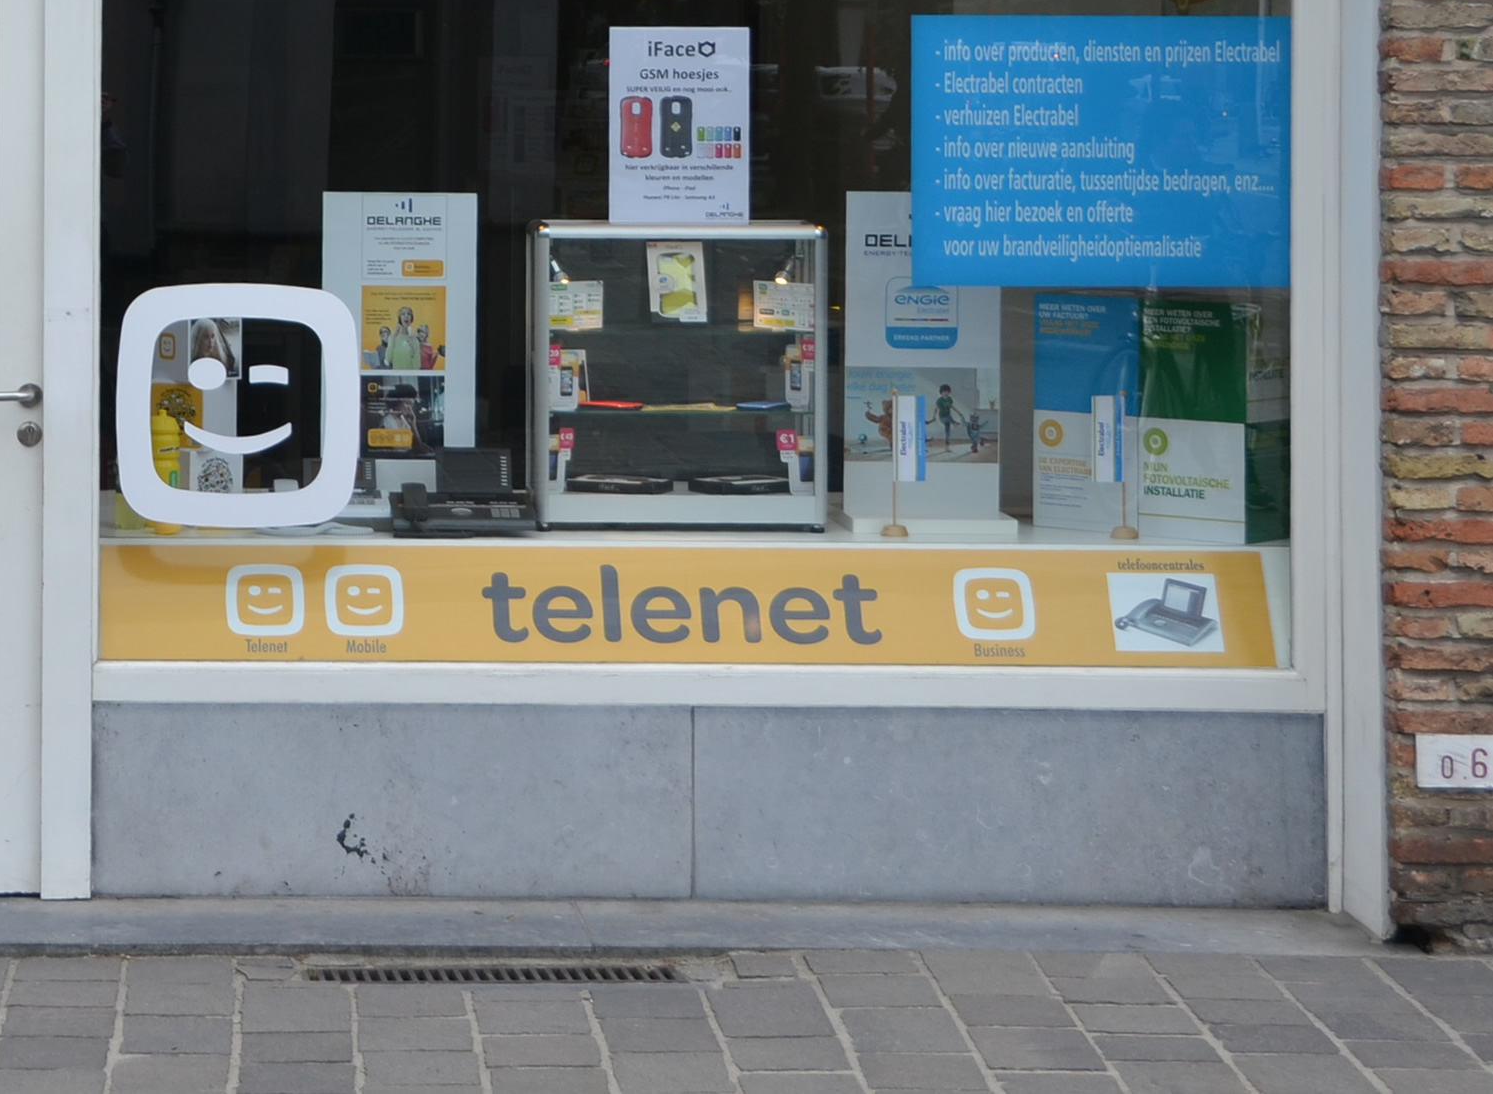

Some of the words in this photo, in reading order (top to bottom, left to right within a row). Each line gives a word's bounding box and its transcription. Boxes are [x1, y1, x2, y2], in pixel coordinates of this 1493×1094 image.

[648, 41, 696, 57] iFace
[943, 40, 970, 61] info
[975, 46, 1004, 61] over
[1008, 40, 1079, 66] producten,
[1083, 40, 1141, 62] diensten
[1144, 47, 1161, 62] en
[1165, 41, 1211, 67] prijzen
[1215, 40, 1280, 63] Electrabel
[639, 68, 669, 80] GSM
[672, 68, 719, 82] hoesjes
[944, 71, 1008, 93] Electrabel
[1012, 74, 1083, 94] contracten
[944, 104, 1009, 126] verhuizen
[1013, 104, 1078, 126] Electrabel
[943, 136, 970, 158] info
[974, 142, 1004, 158] over
[1008, 138, 1057, 158] nieuwe
[1061, 137, 1135, 163] aansluiting
[943, 168, 970, 190] info
[974, 174, 1004, 190] over
[1008, 168, 1075, 193] facturatie,
[1079, 169, 1159, 196] tussentijdse
[1163, 170, 1231, 196] bedragen,
[943, 205, 981, 227] vraag
[985, 200, 1011, 222] hier
[1015, 200, 1062, 222] bezoek
[1066, 207, 1083, 222] en
[1087, 201, 1133, 222] offerte
[943, 239, 975, 257] voor
[978, 240, 999, 257] uw
[779, 433, 795, 444] €1
[1117, 558, 1205, 572] telefooncentrales
[481, 564, 882, 645] telenet
[245, 638, 288, 654] Telenet
[346, 638, 387, 654] Mobile
[973, 643, 1026, 658] Business
